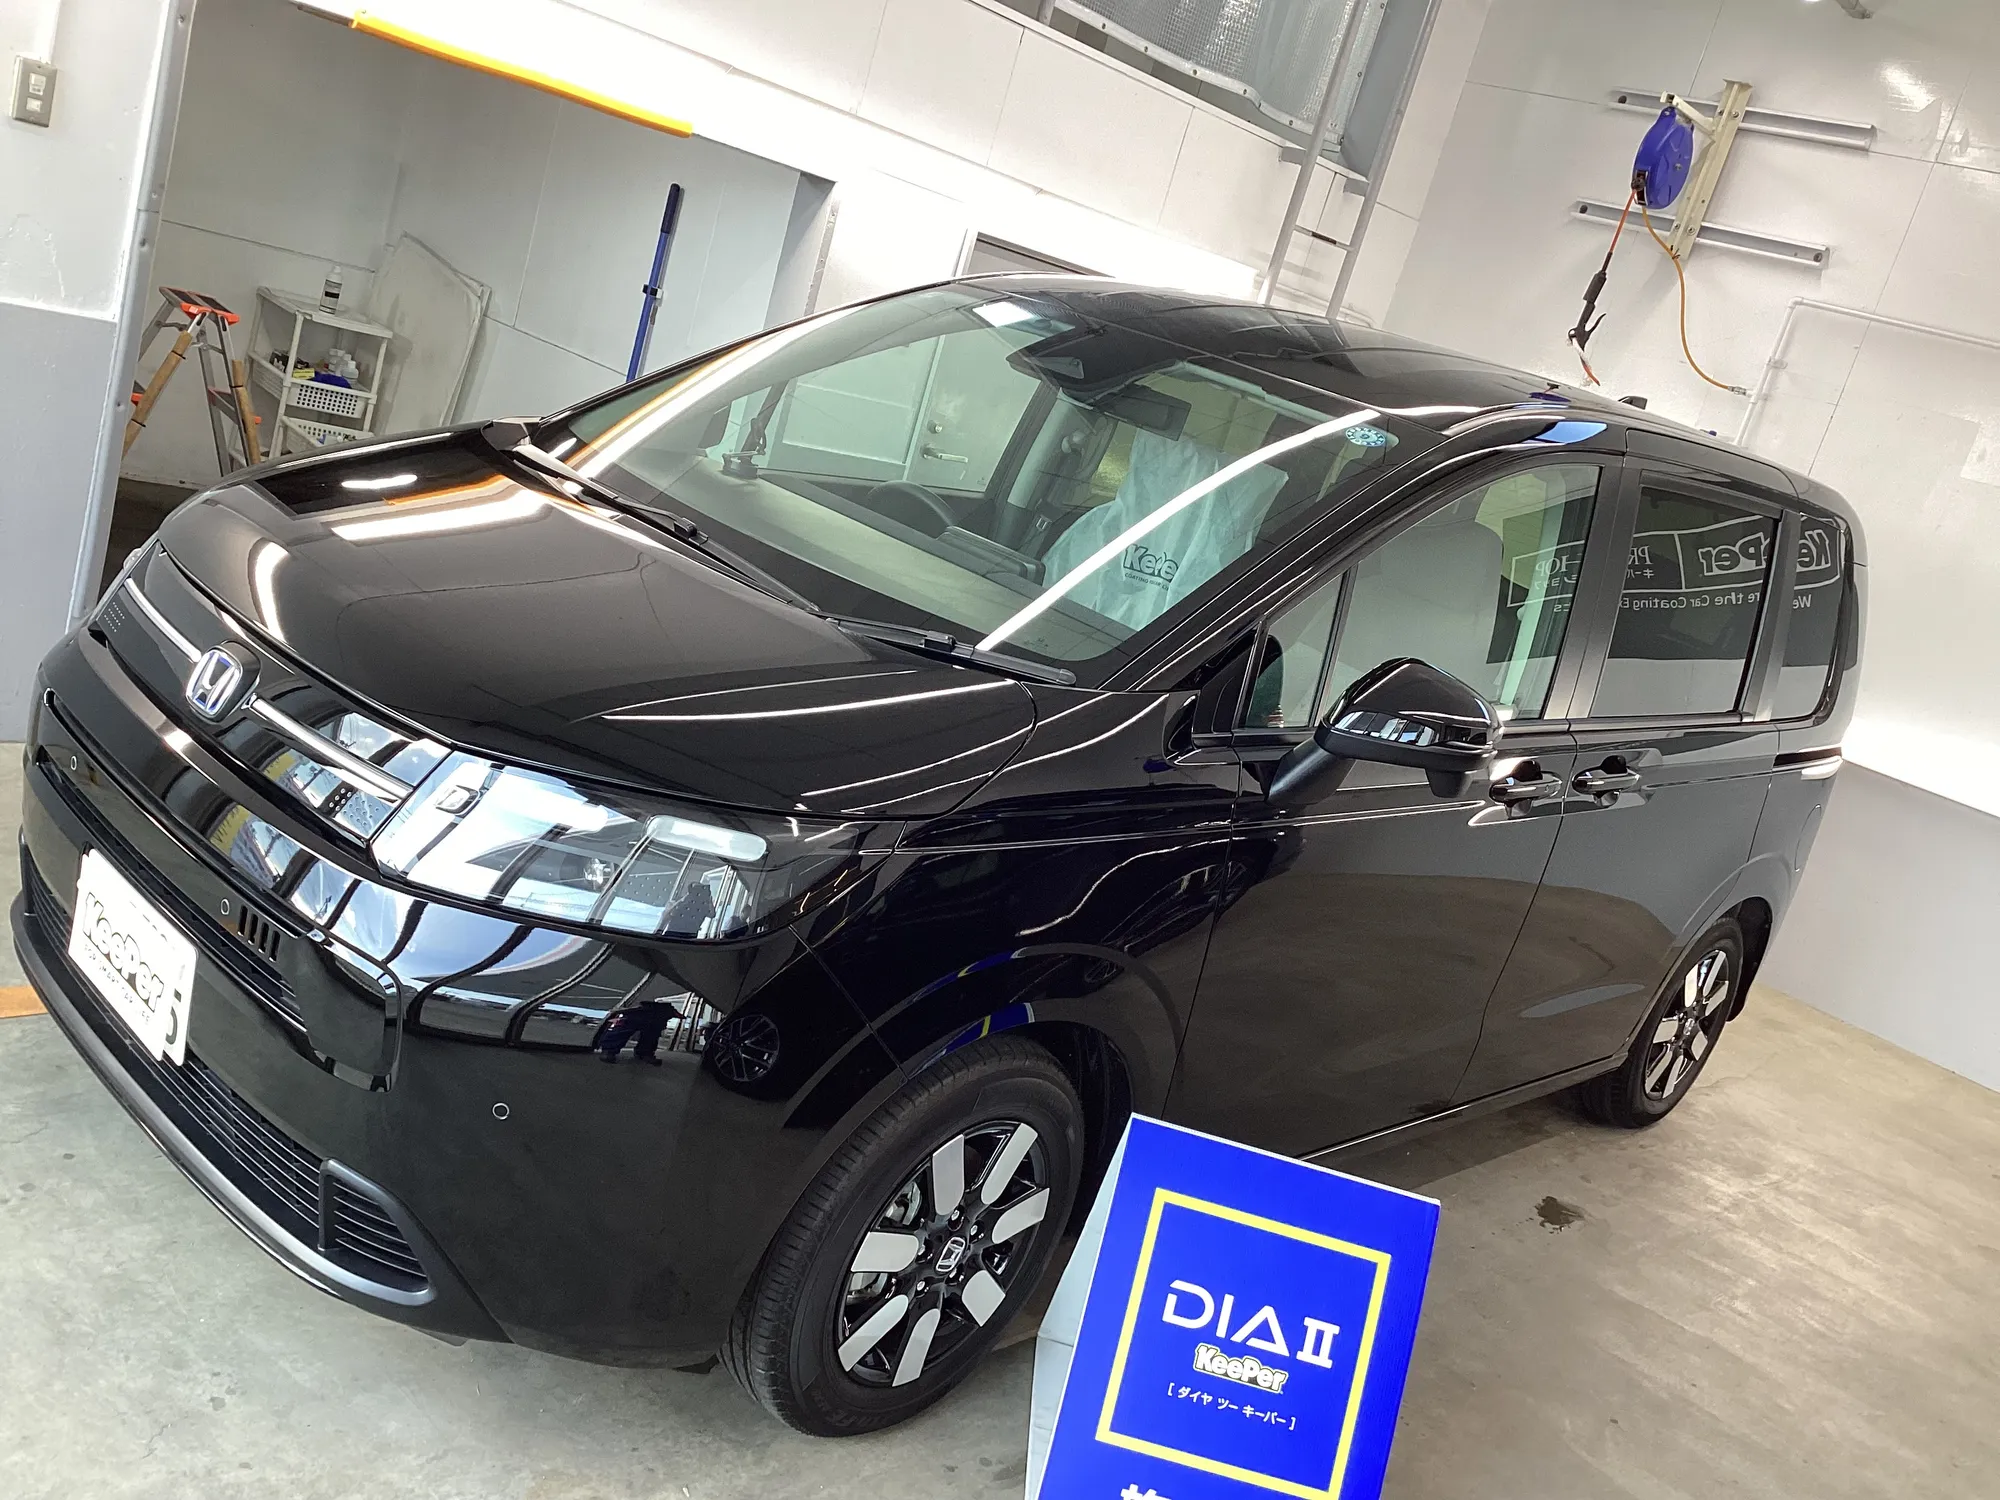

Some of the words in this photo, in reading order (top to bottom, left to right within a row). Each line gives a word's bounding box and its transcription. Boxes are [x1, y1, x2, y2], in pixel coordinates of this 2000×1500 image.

[83, 892, 165, 1013] KeePer
[1162, 1279, 1290, 1357] DIA
[1193, 1343, 1289, 1394] KeePer
